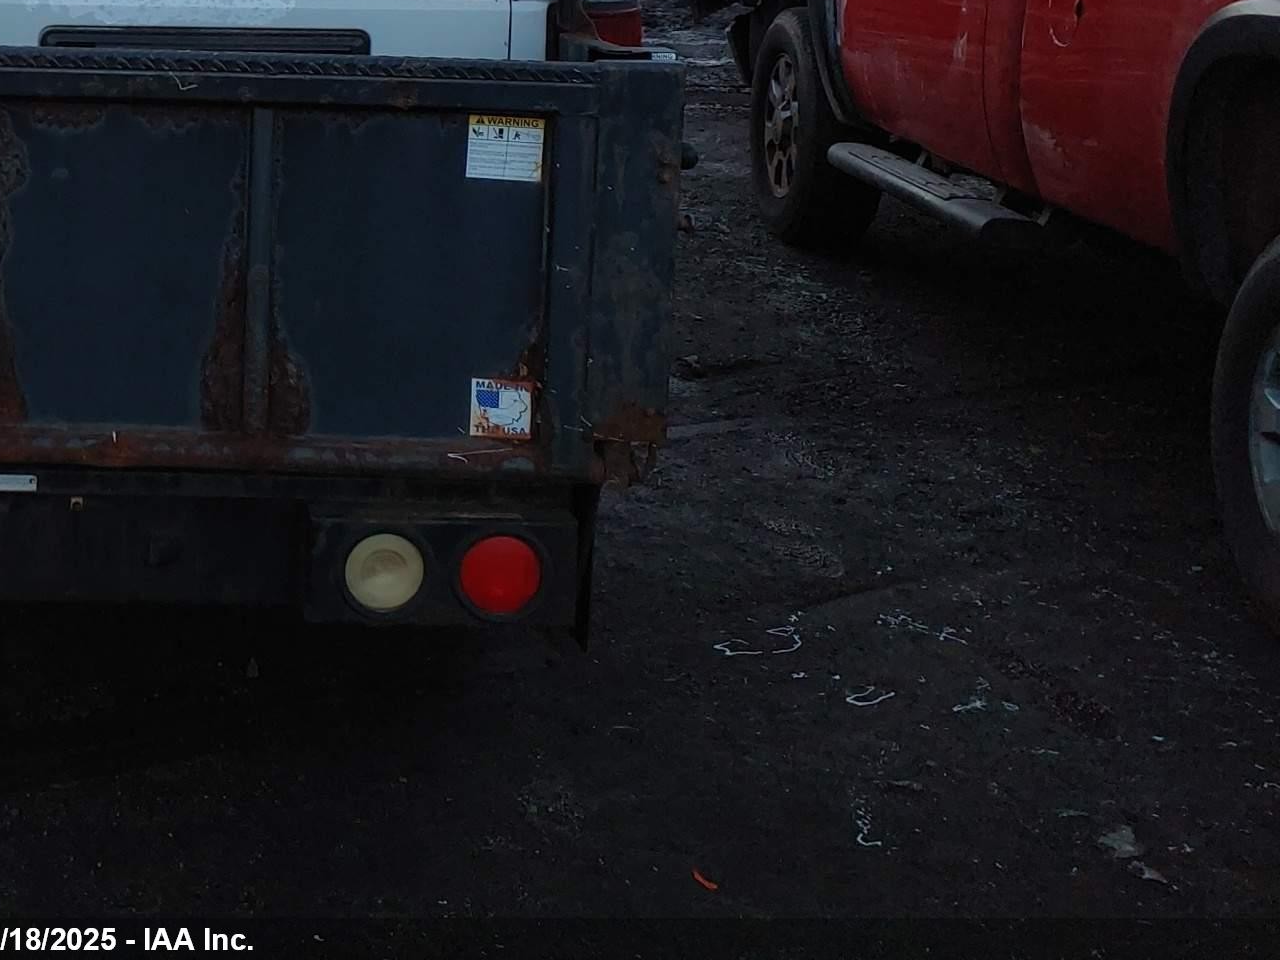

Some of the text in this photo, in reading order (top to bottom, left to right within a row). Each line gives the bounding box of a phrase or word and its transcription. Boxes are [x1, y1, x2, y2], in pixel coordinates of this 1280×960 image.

[488, 117, 539, 128] WARNING
[476, 381, 511, 391] MADE
[474, 422, 528, 437] TH USA
